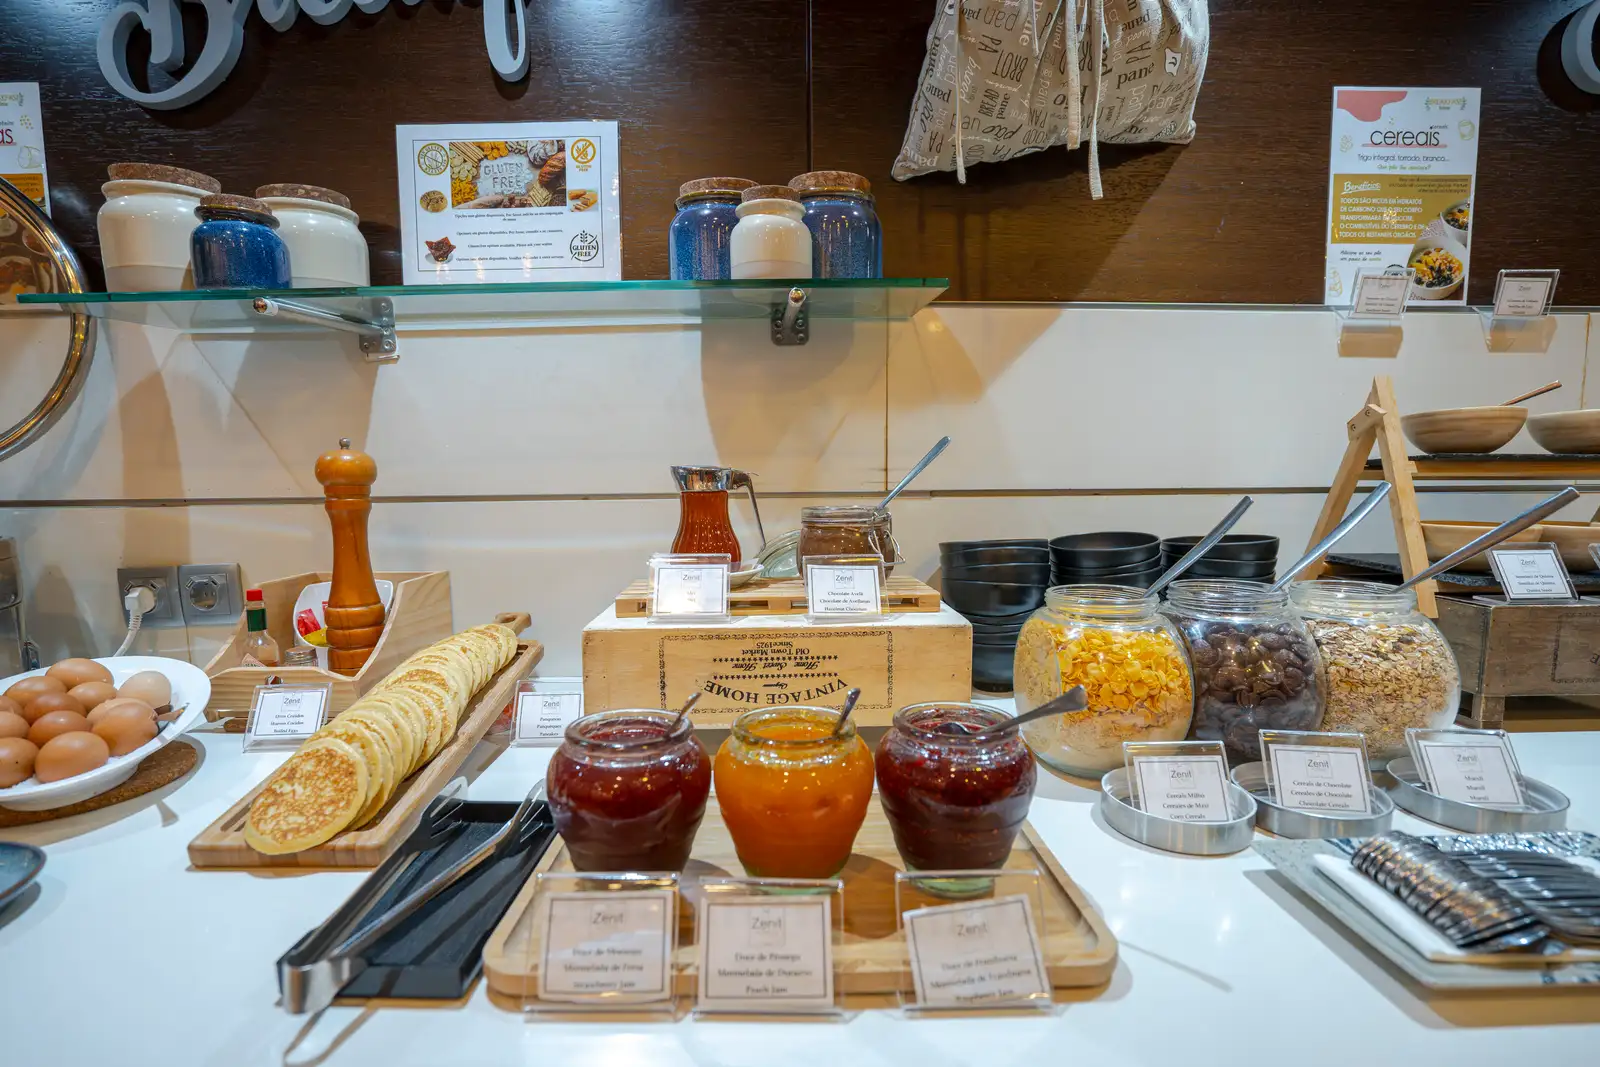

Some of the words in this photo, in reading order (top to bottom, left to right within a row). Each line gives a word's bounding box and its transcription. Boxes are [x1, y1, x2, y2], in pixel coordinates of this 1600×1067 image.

[983, 6, 1020, 31] pan
[992, 50, 1028, 82] BROT
[1116, 62, 1155, 89] pane
[916, 83, 951, 103] pane
[979, 88, 1000, 117] BREAD
[982, 123, 1023, 141] pão
[1370, 130, 1440, 146] cereais
[484, 162, 524, 175] GLUTEN
[492, 175, 522, 188] FREE
[704, 680, 759, 704] HOME
[766, 679, 848, 704] VINTAGE
[1307, 759, 1330, 768] Zenit
[1171, 770, 1192, 779] Zenit
[592, 912, 624, 925] Zenit
[751, 917, 782, 930] Zenit
